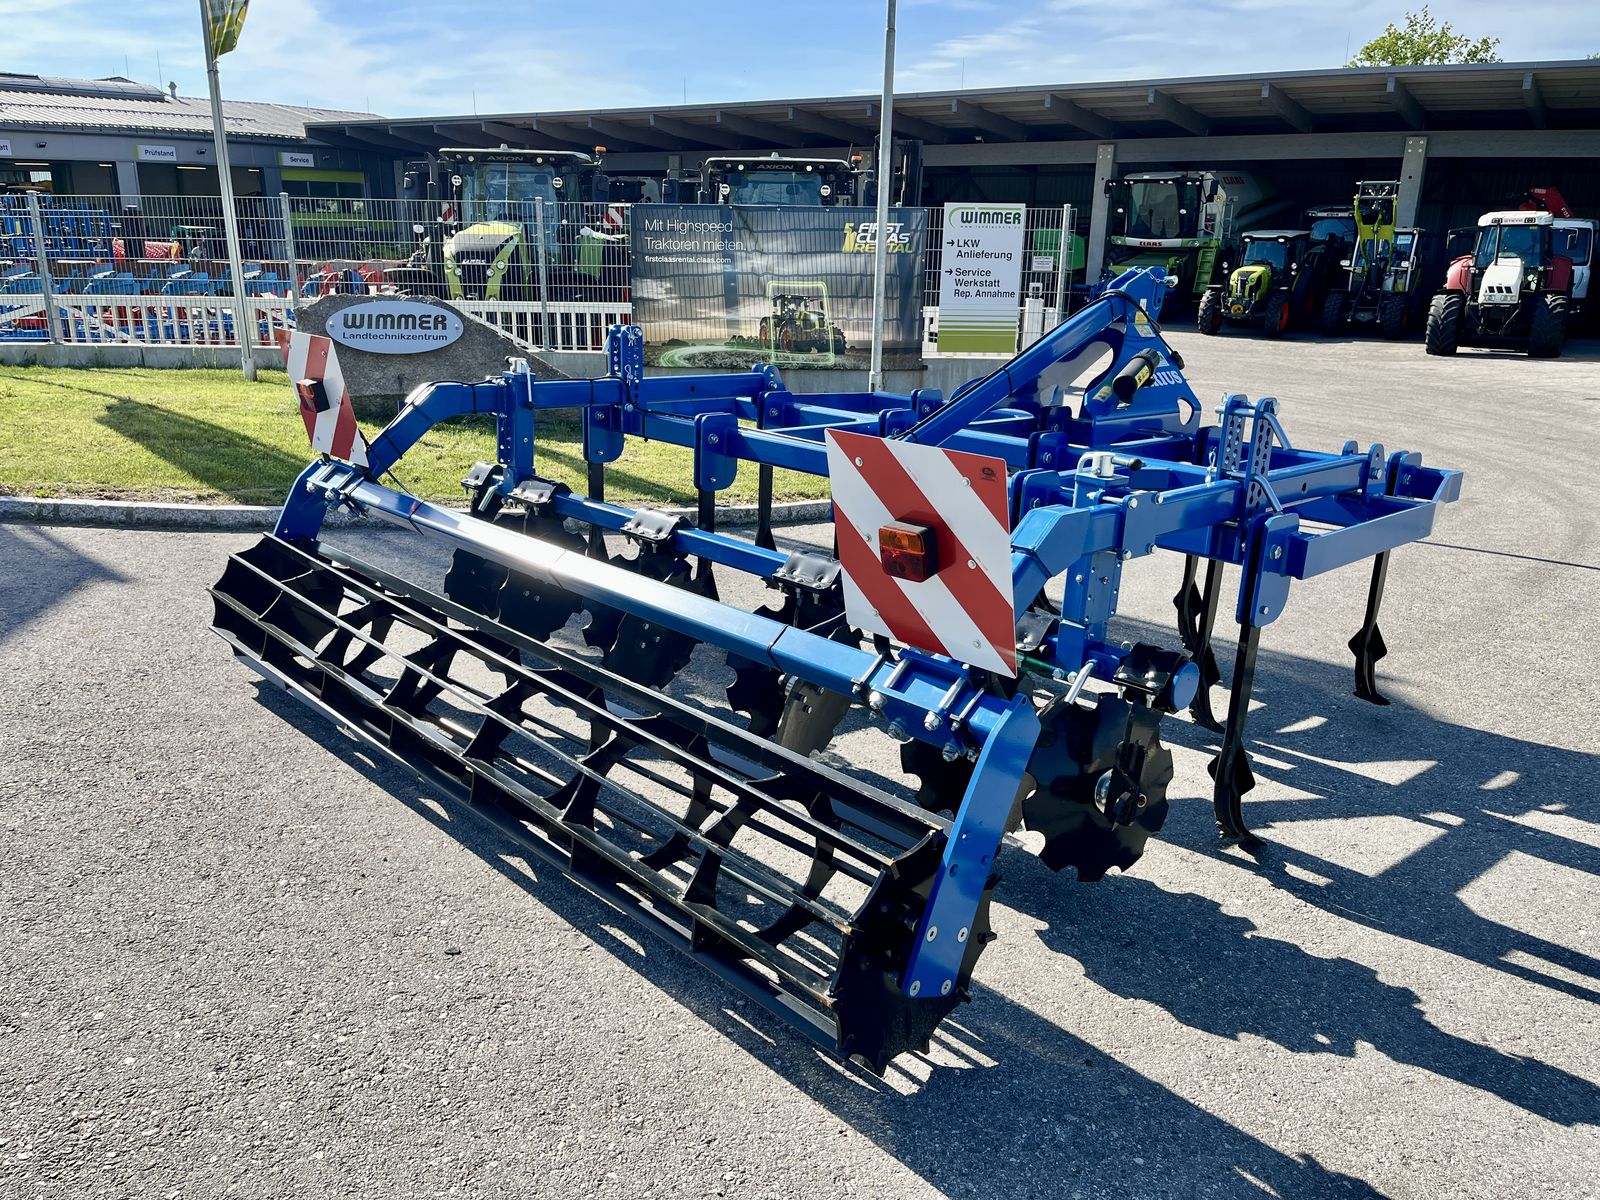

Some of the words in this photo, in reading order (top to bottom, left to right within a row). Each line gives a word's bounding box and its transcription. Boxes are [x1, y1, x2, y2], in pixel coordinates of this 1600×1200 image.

[144, 149, 174, 157] Prüfstand
[290, 156, 310, 164] Service
[961, 211, 1021, 224] WIMMER
[644, 219, 664, 232] Mit
[666, 219, 733, 235] Highspeed
[855, 233, 911, 243] CLAS
[644, 236, 700, 250] Traktoren
[702, 239, 747, 251] mieten.
[853, 243, 913, 253] RETAL
[956, 239, 981, 248] LKW
[644, 255, 732, 264] firstclaasrental.claas.com
[956, 250, 1013, 261] Anlieferung
[954, 267, 992, 277] Service
[954, 278, 1001, 288] Werkstatt
[953, 288, 973, 300] Rep.
[974, 289, 1016, 298] Annahme
[343, 313, 447, 330] WIMMER
[342, 332, 448, 340] Landtechnikzentrum
